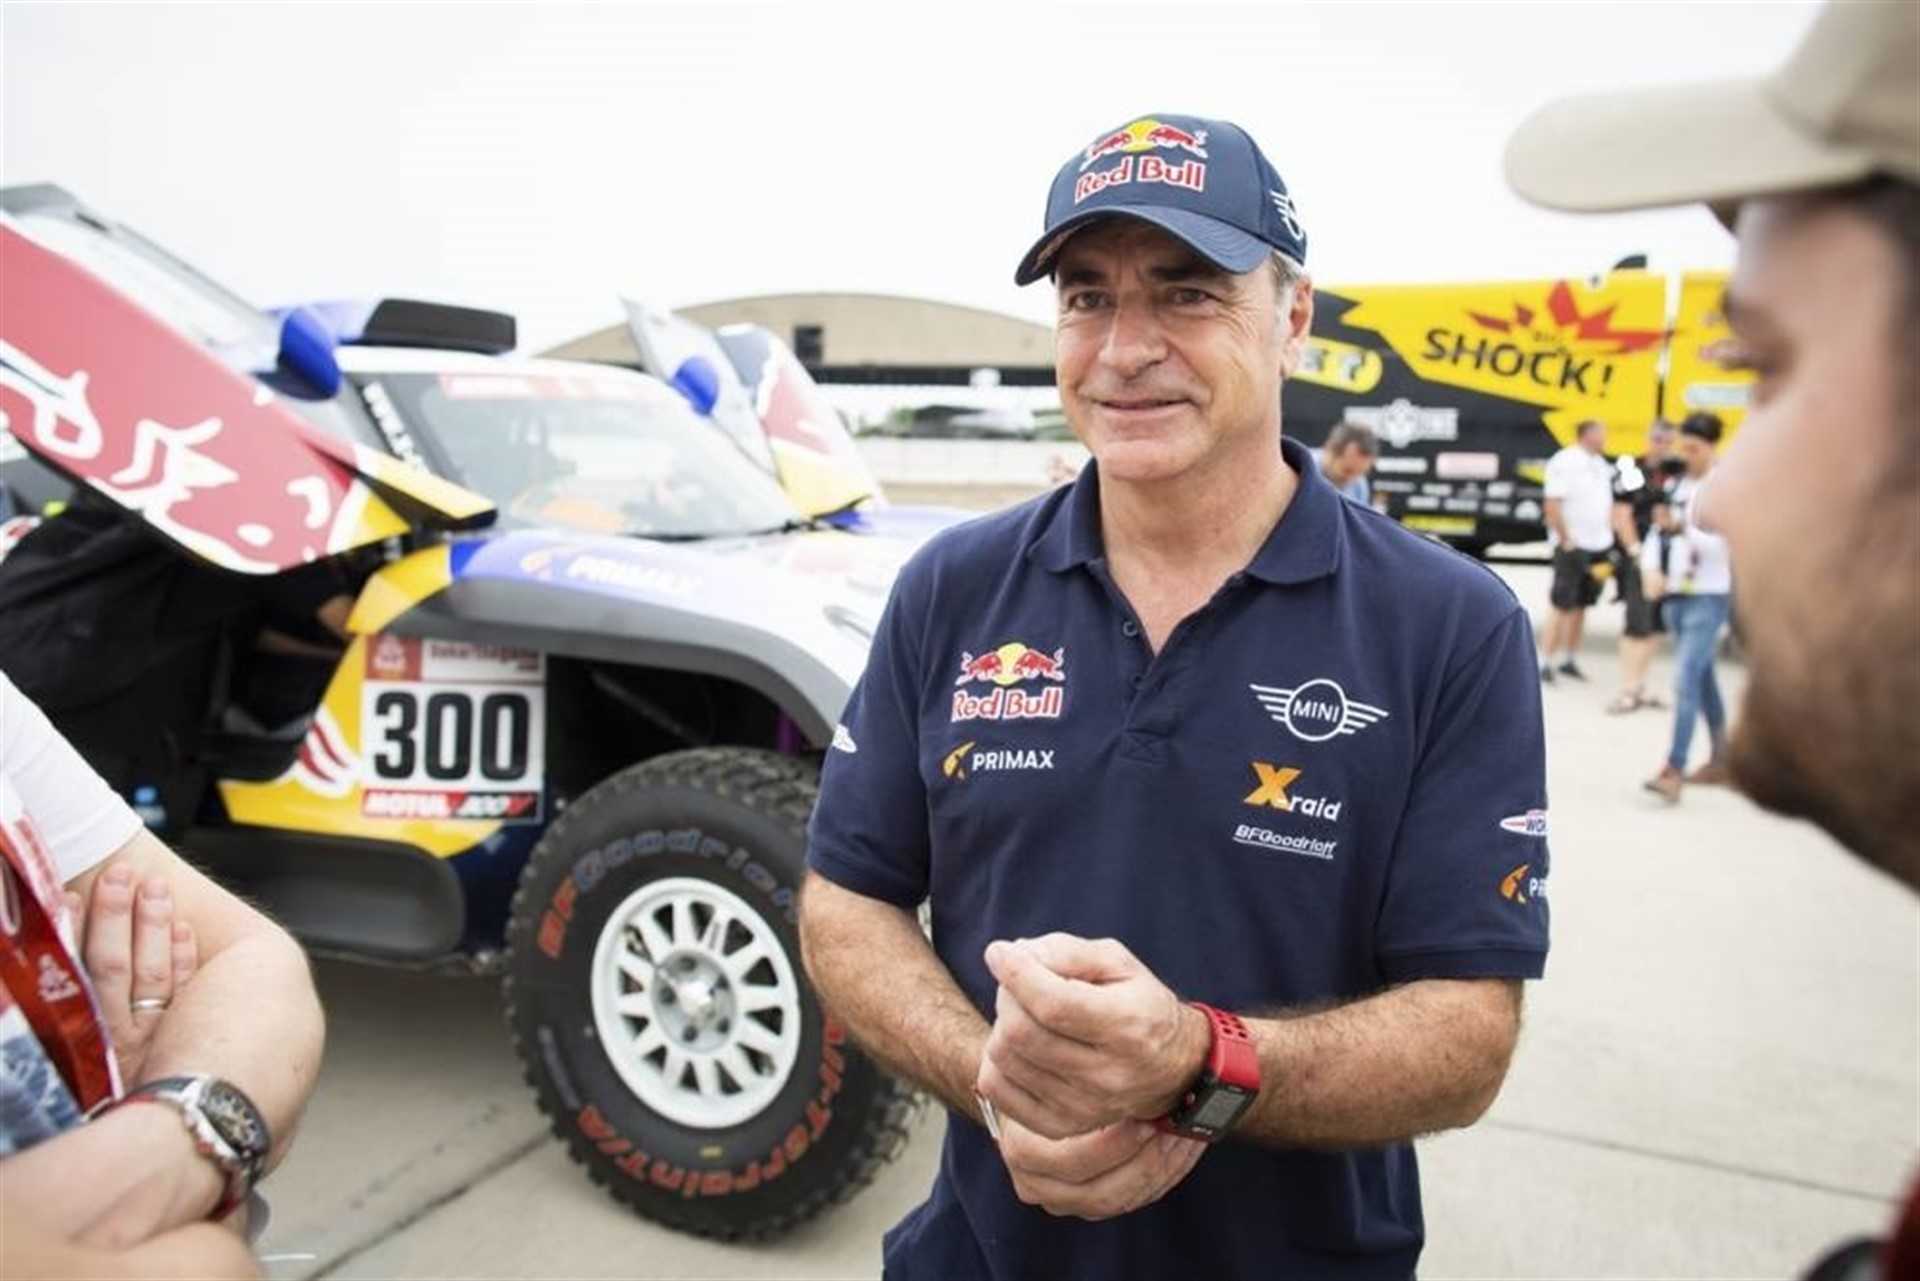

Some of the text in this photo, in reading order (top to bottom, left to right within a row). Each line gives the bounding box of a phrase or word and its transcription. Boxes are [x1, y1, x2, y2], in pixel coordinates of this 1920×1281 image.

[1075, 155, 1206, 204] Red Bull
[1422, 327, 1613, 398] SHOCK!
[952, 687, 1063, 721] Red Bull
[1292, 698, 1341, 724] MINI
[374, 691, 530, 781] 300
[972, 750, 1055, 771] PRIMAX
